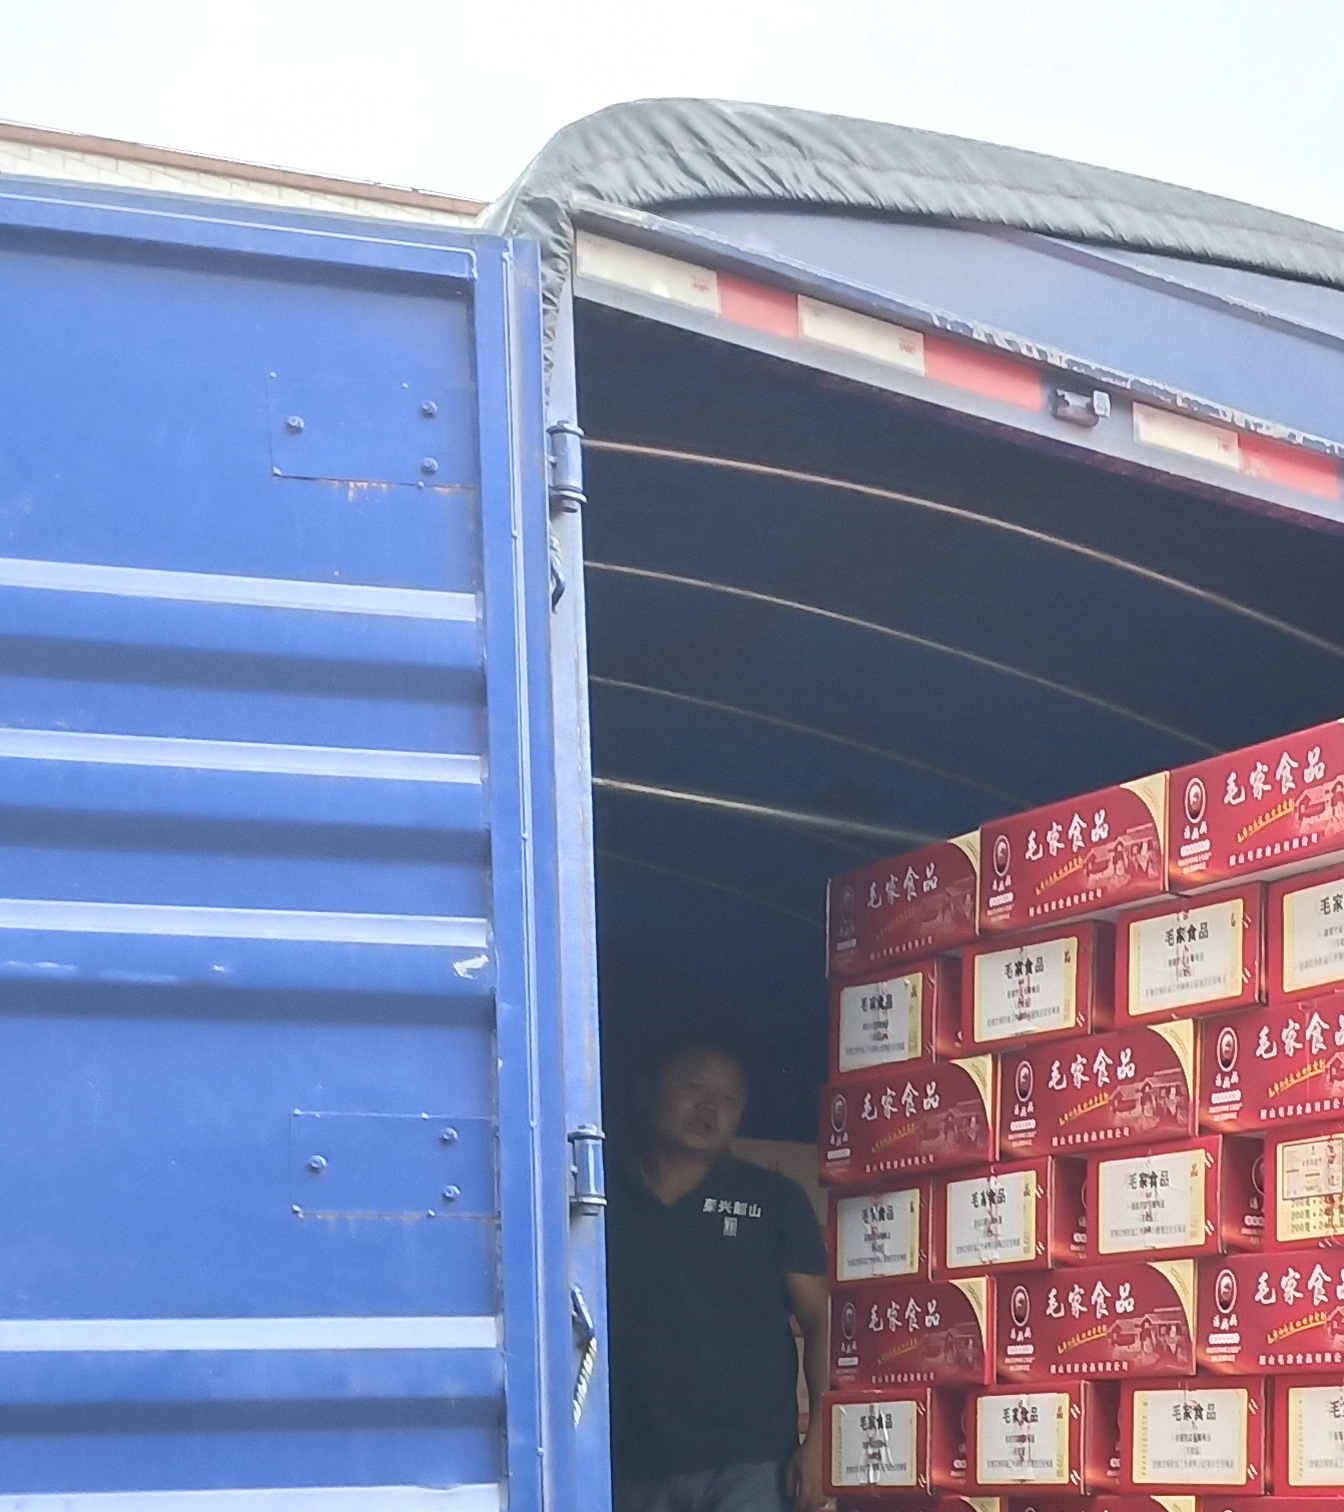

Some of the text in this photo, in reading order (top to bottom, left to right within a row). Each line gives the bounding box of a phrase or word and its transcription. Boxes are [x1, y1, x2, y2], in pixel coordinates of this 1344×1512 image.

[1223, 746, 1326, 806] 毛家食品
[1025, 808, 1110, 861] 毛家食品
[866, 862, 939, 909] 毛家食品
[1164, 922, 1209, 948] 毛家食品
[1003, 956, 1045, 980] 毛家食品
[1048, 1047, 1137, 1092] 毛家食品
[860, 1080, 941, 1122] 毛家食品
[1128, 1168, 1170, 1191] 毛家食品
[868, 1297, 942, 1333] 毛家食品
[1046, 1280, 1135, 1320] 毛家食品
[1002, 1405, 1039, 1425] 毛家食品
[1172, 1403, 1217, 1423] 毛家食品
